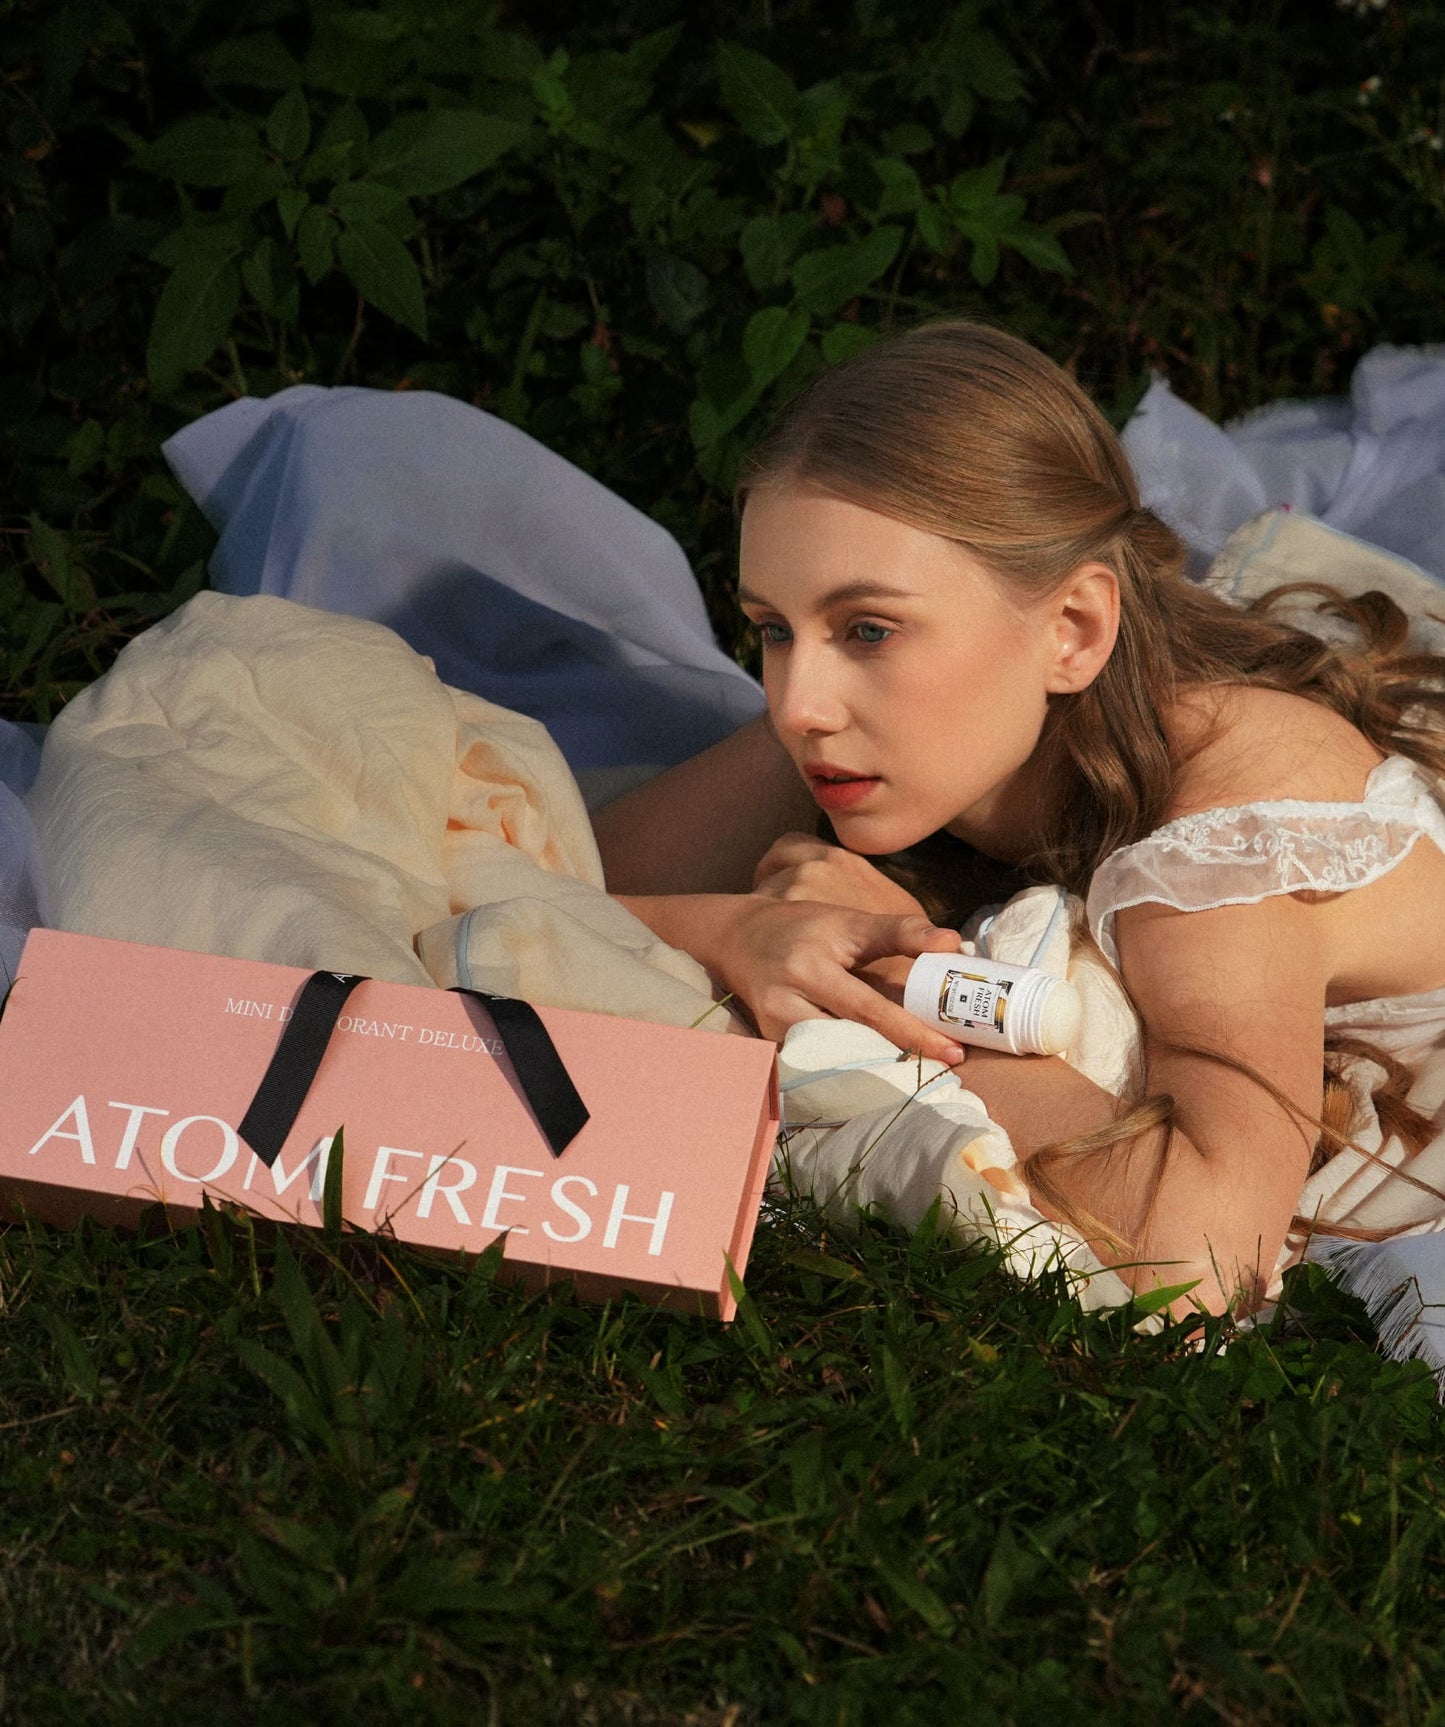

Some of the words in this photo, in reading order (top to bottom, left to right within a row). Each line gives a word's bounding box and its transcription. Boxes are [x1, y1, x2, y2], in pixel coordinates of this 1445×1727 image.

[224, 997, 273, 1020] MINI
[278, 1006, 413, 1041] DORANT
[417, 1028, 504, 1056] DELUXE
[28, 1094, 335, 1203] ATOM
[363, 1146, 675, 1256] FRESH
